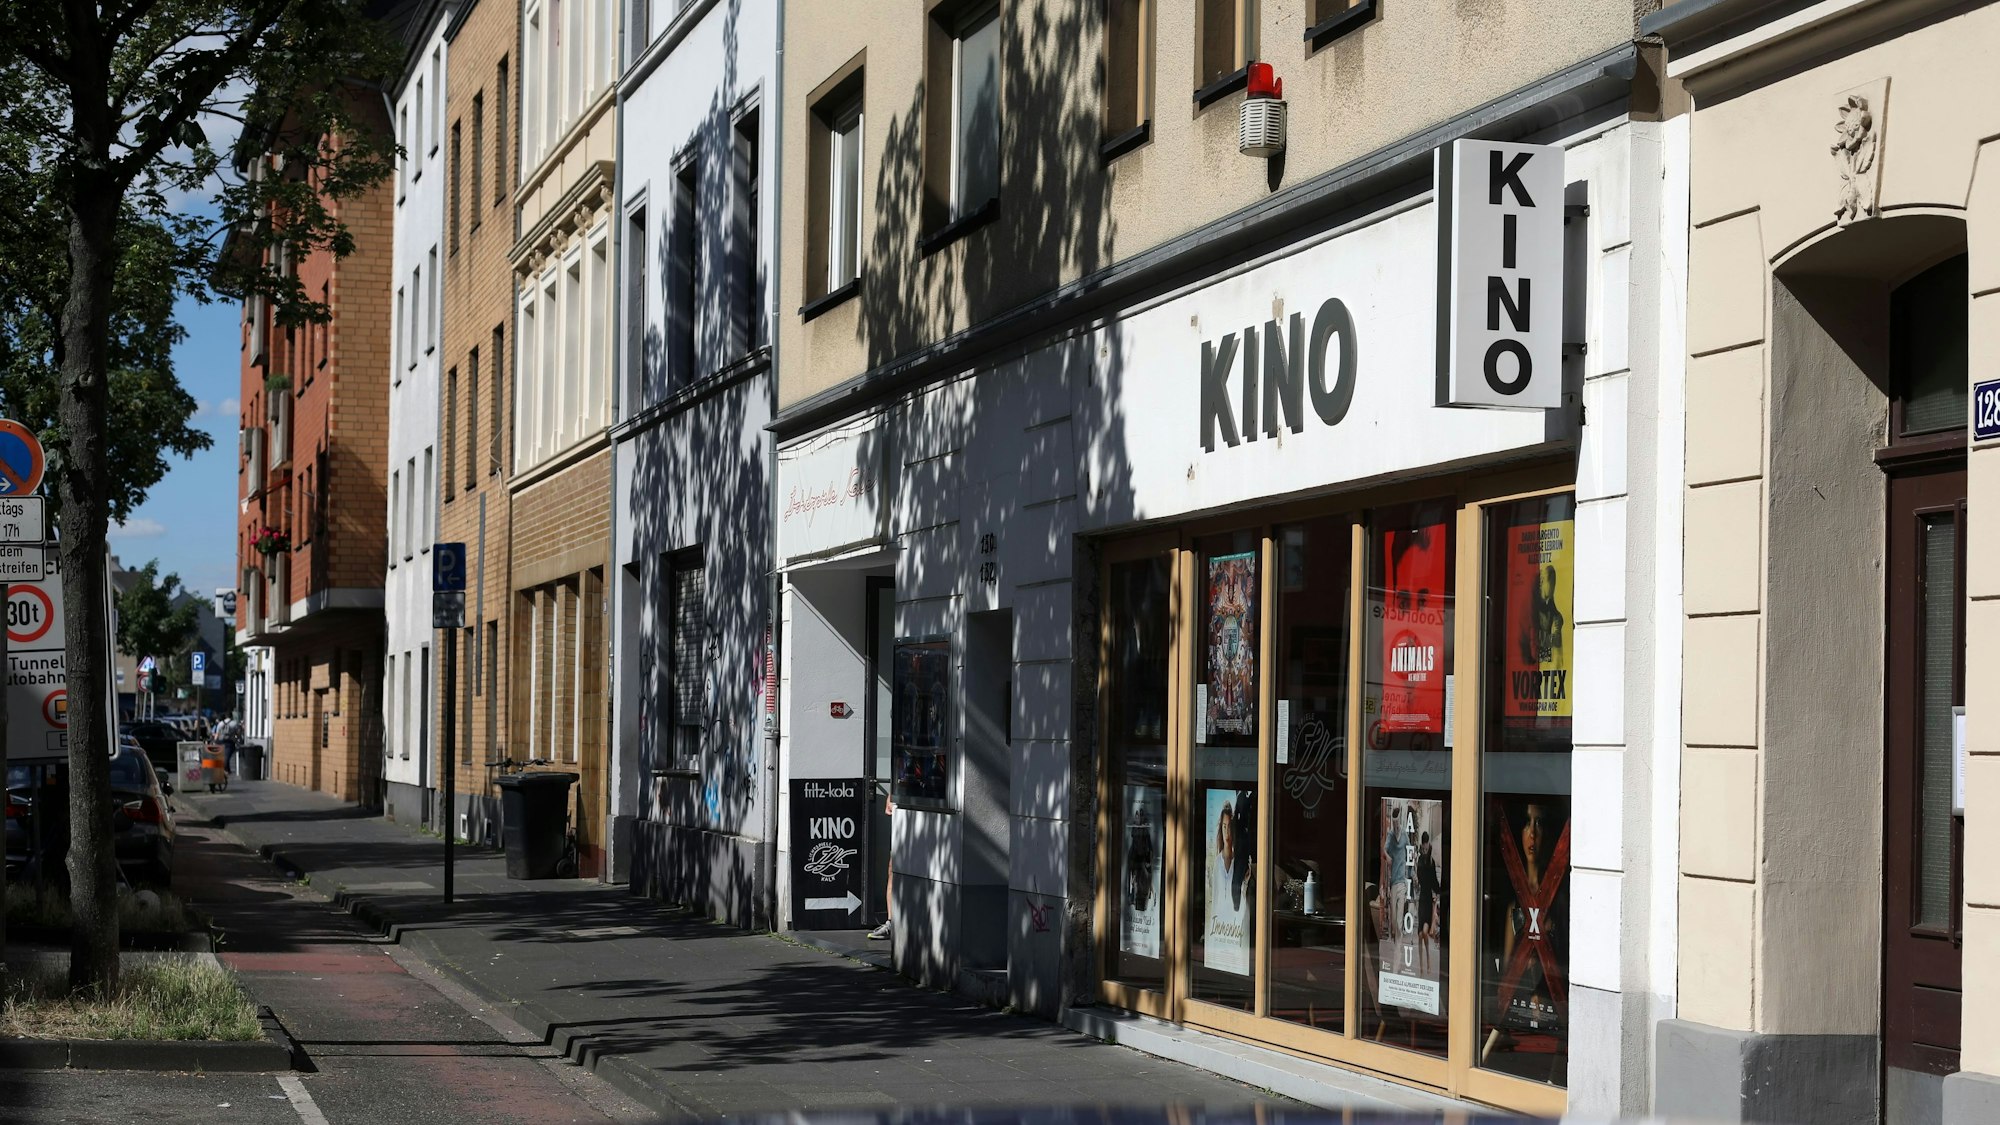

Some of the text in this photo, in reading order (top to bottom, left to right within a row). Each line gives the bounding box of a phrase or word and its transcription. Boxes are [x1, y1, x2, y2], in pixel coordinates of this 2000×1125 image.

[1483, 150, 1536, 395] KINO
[1200, 297, 1358, 454] KINO
[0, 502, 23, 517] tags
[9, 655, 65, 671] Tunnel
[1391, 646, 1434, 672] ANIMALS
[1512, 670, 1566, 699] VORTEX
[804, 782, 854, 798] fritz-kola
[809, 817, 855, 839] KINO
